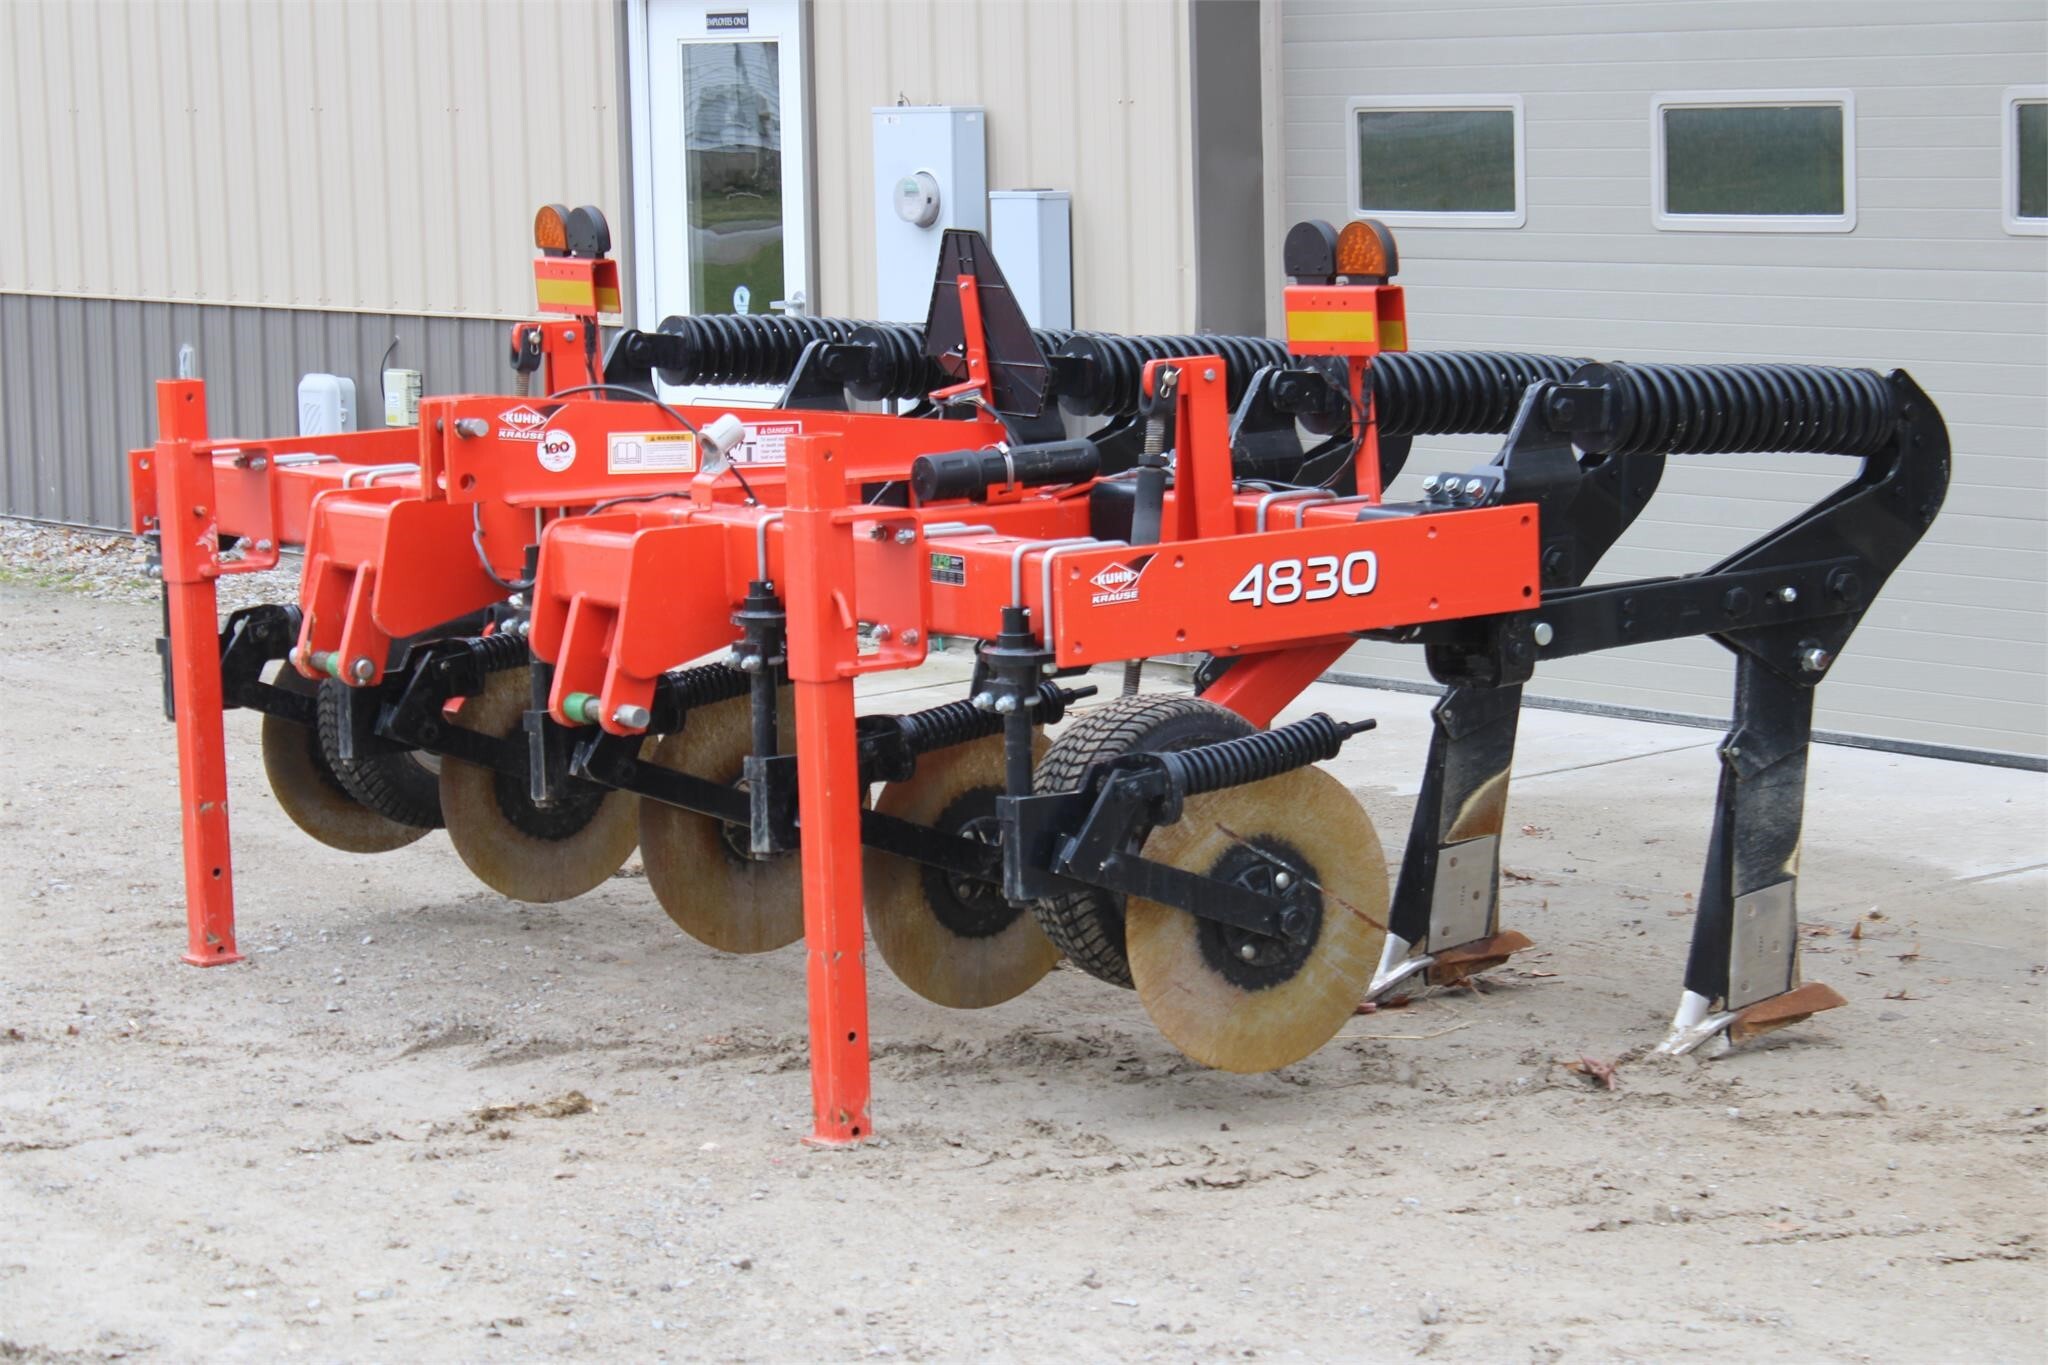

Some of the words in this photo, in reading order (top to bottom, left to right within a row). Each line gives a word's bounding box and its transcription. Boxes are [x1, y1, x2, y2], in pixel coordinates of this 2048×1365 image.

[706, 17, 732, 26] EMPLOYEES
[733, 16, 747, 25] ONLY
[505, 412, 541, 424] KUHN
[498, 429, 545, 440] KRAUSE
[766, 426, 795, 434] DANGER
[542, 441, 570, 455] 100
[1096, 570, 1133, 585] KUHN
[1228, 550, 1378, 607] 4830
[1092, 590, 1138, 604] KRAUSE
